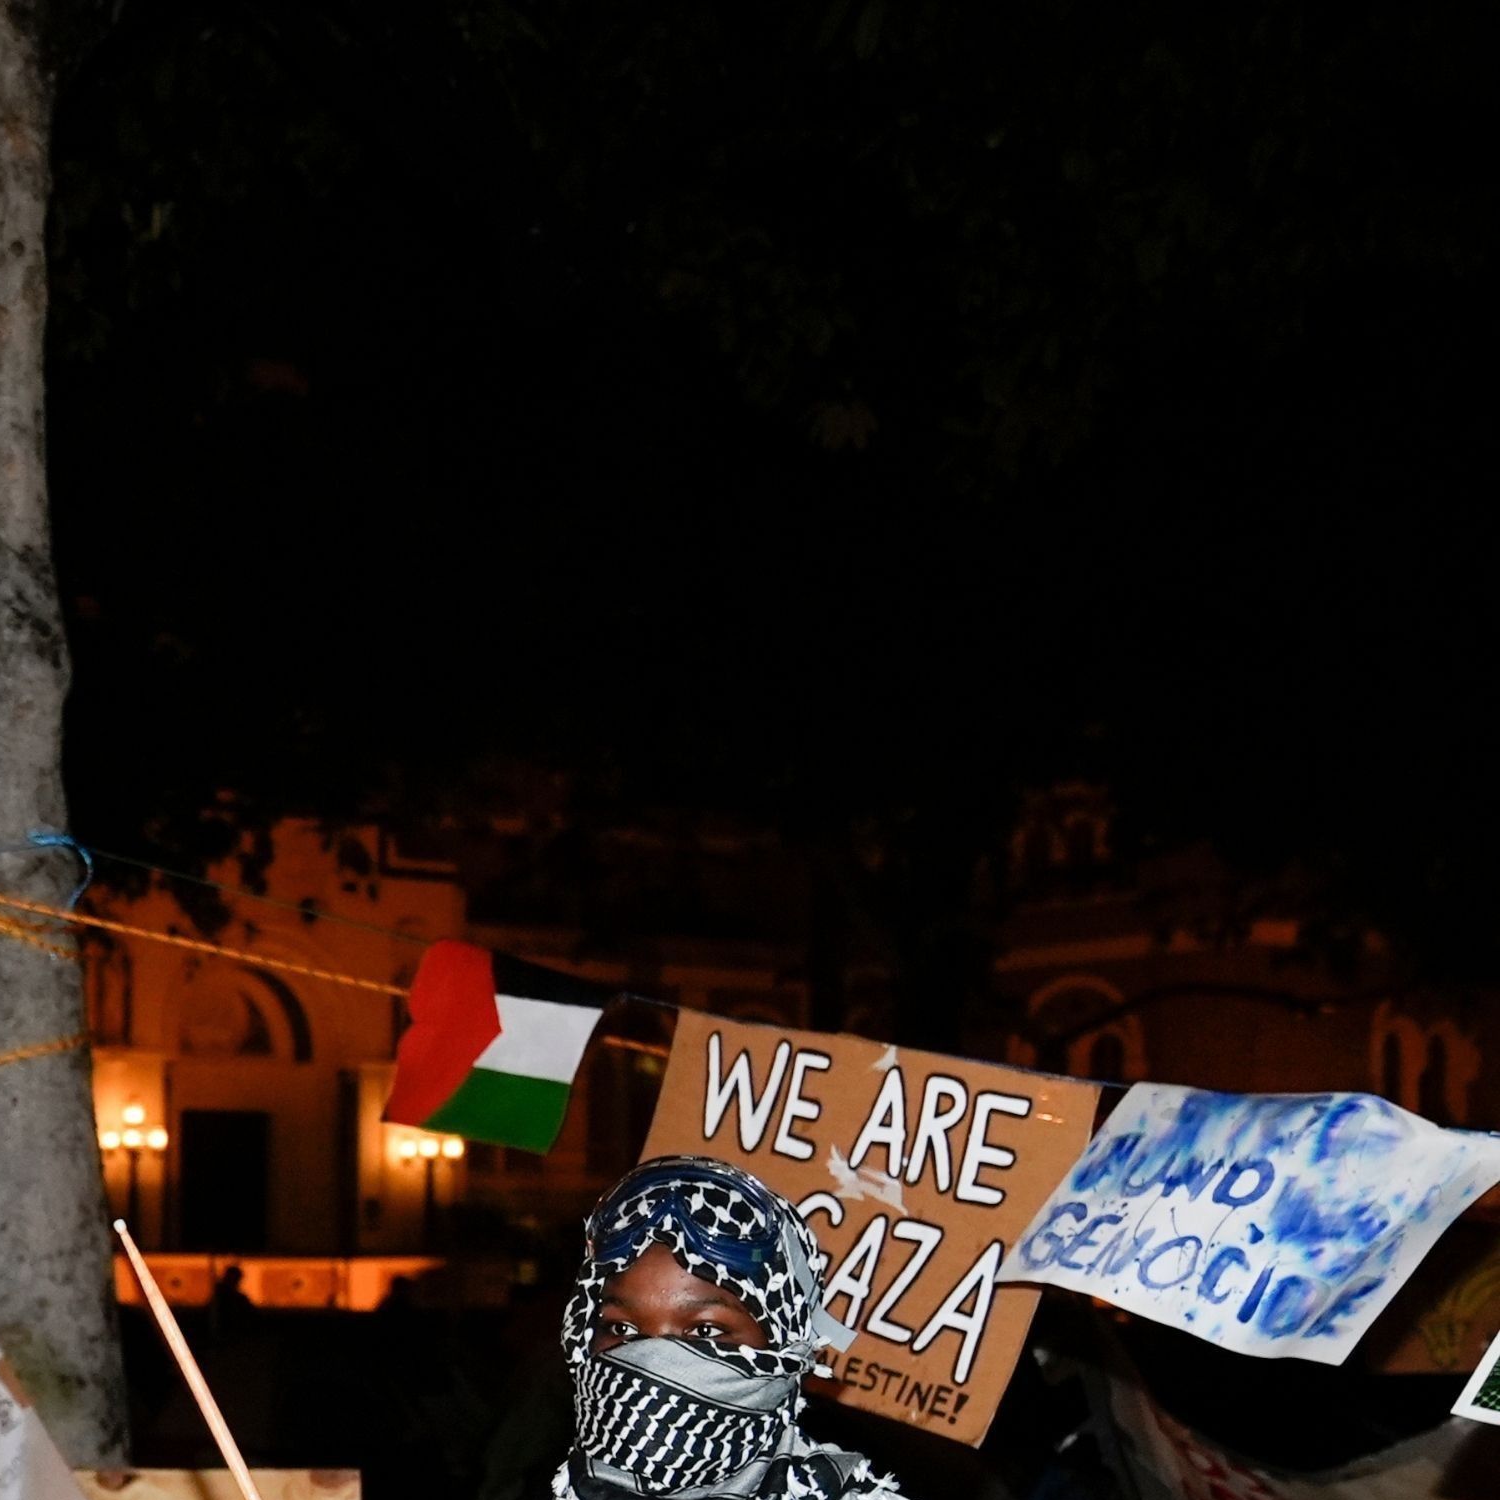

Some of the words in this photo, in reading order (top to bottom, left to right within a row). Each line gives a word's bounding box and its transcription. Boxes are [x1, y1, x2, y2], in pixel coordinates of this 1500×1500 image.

[702, 1029, 832, 1162] WE
[847, 1063, 1032, 1207] ARE
[812, 1350, 970, 1425] ALESTINE!
